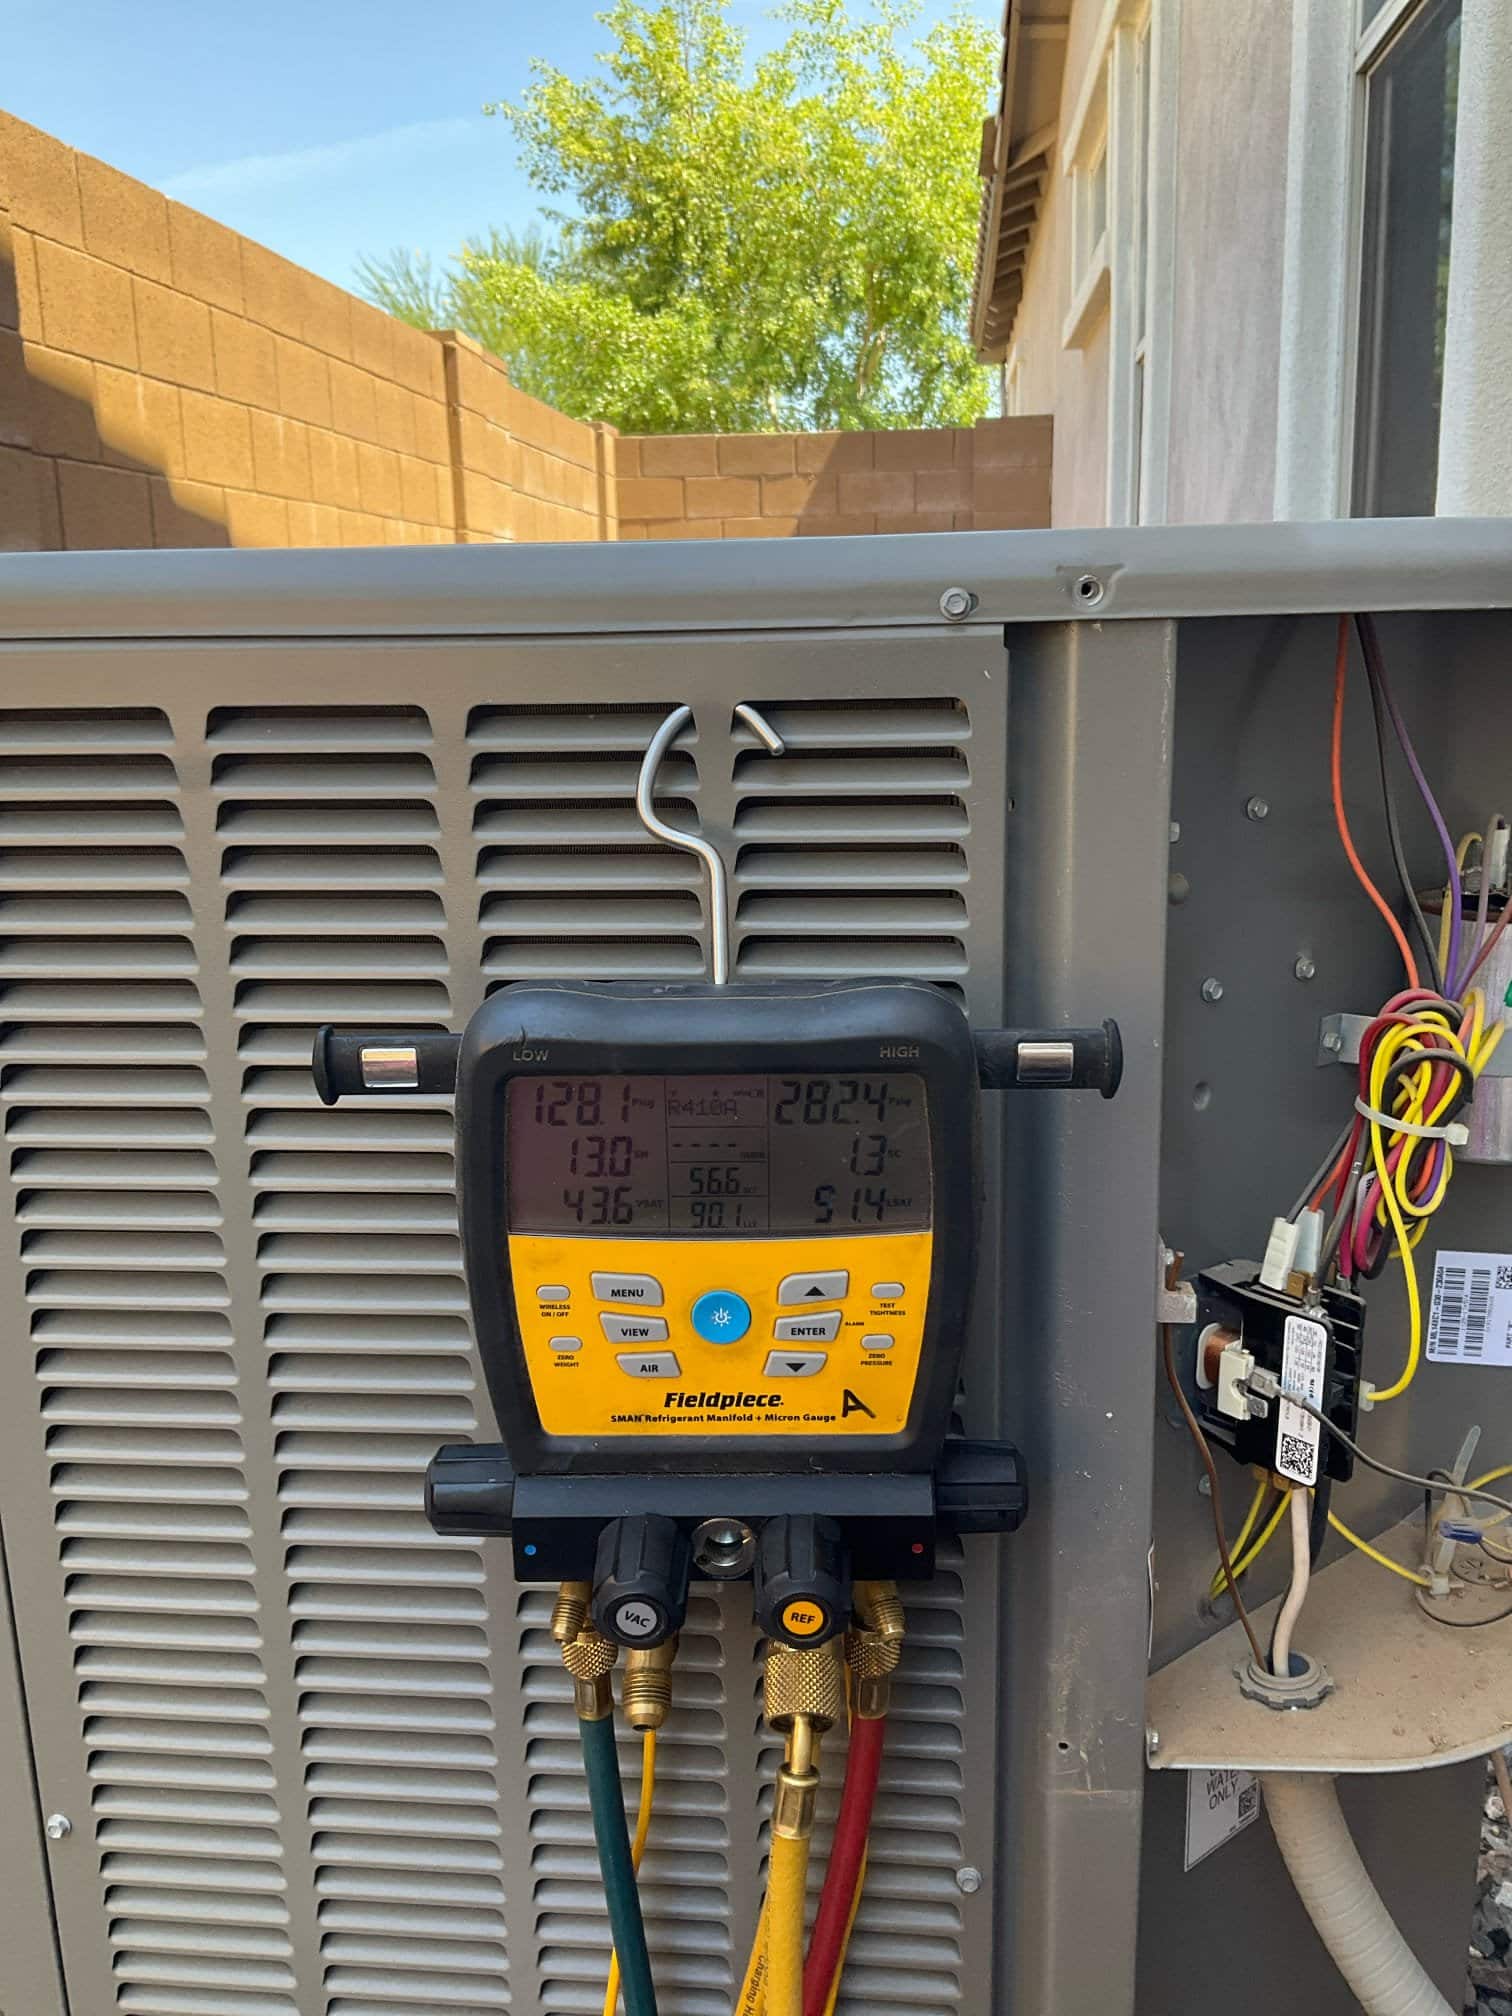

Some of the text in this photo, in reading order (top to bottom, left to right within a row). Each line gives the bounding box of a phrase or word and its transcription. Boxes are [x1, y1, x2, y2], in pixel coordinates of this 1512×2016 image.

[512, 1050, 549, 1061] LOW
[880, 1046, 920, 1058] HIGH
[535, 1082, 631, 1126] 128.1
[774, 1080, 888, 1125] 282.4
[569, 1136, 632, 1177] 13.0
[563, 1186, 632, 1224] 43.6
[610, 1288, 645, 1298] MENU
[620, 1327, 649, 1337] VIEW
[790, 1327, 826, 1336] ENTER
[639, 1364, 659, 1373] AIR
[664, 1392, 782, 1410] Fieldpiece
[841, 1388, 877, 1418] A
[645, 1414, 704, 1424] Refrigerant
[706, 1413, 753, 1422] Manifold
[765, 1413, 800, 1422] Micron
[803, 1413, 836, 1424] Gauge
[622, 1610, 652, 1629] VAC
[789, 1611, 817, 1625] REF
[1209, 1778, 1239, 1810] ONLY
